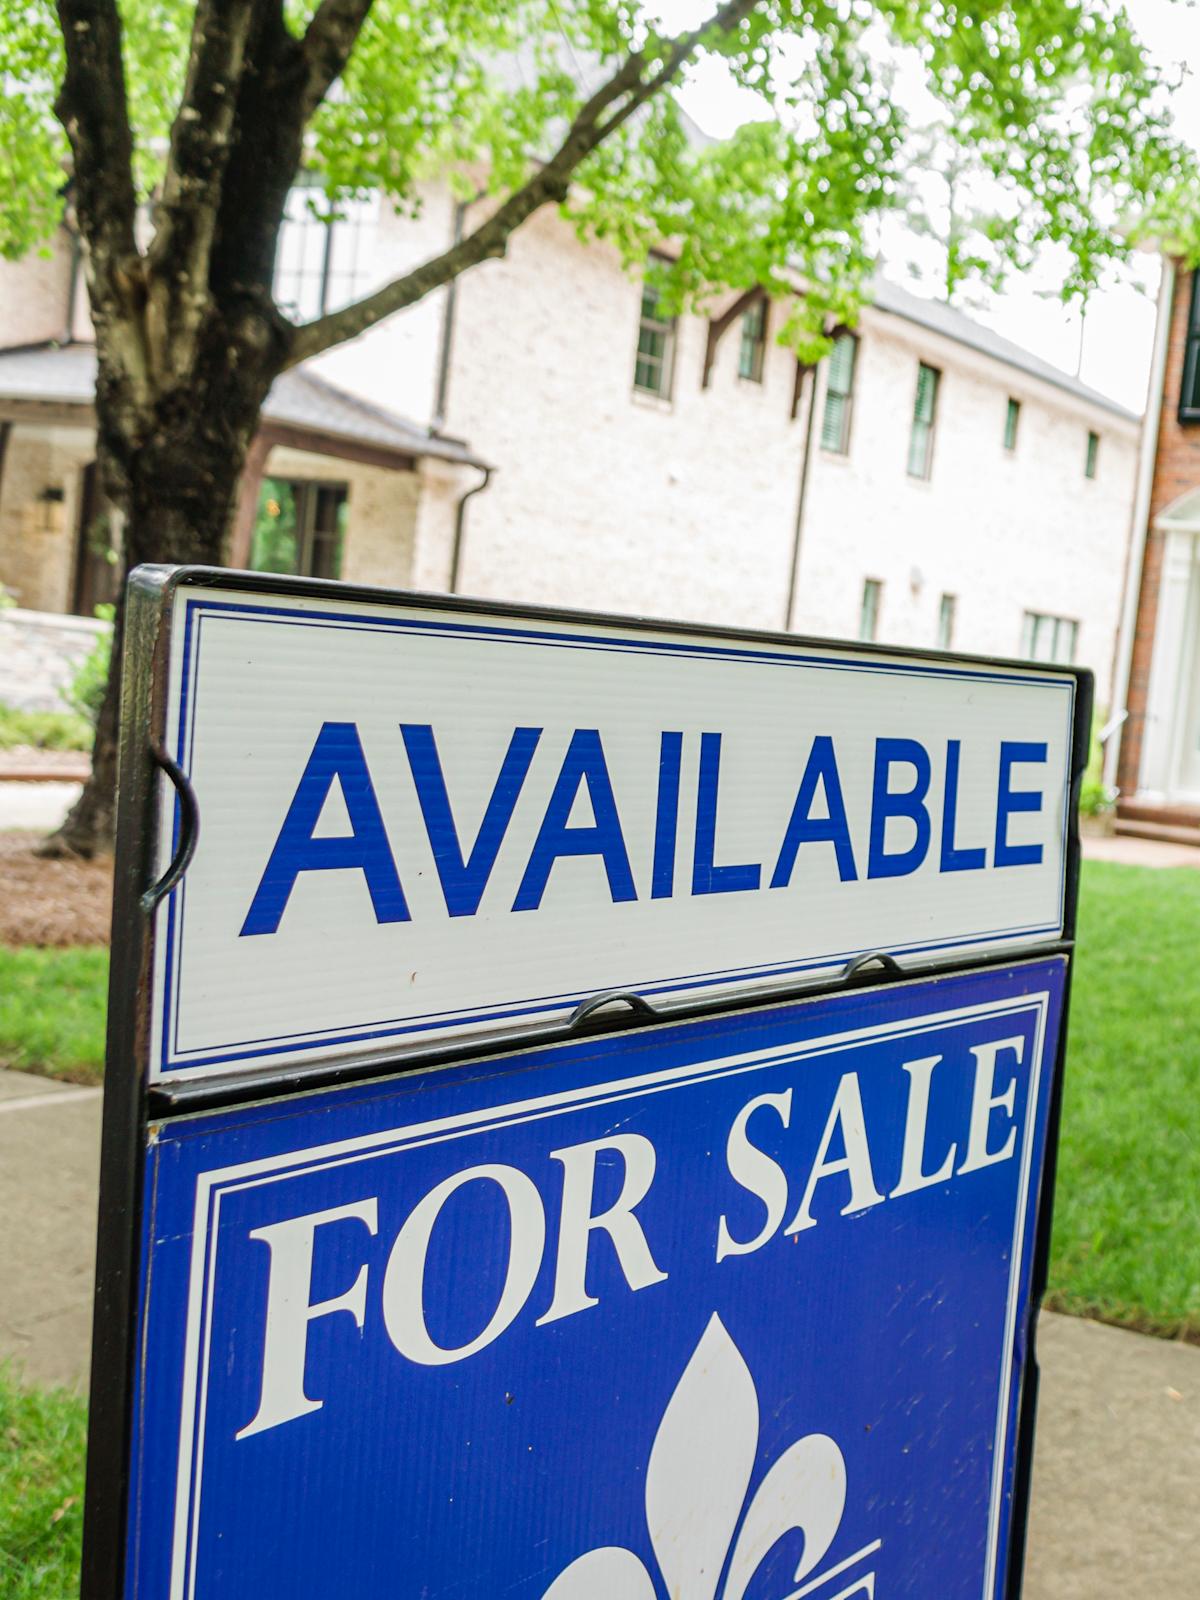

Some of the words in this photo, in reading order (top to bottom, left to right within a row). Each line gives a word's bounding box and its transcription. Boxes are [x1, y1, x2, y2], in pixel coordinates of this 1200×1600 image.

[240, 722, 1049, 936] AVAILABLE
[235, 1133, 669, 1441] FOR
[715, 1035, 1025, 1264] SALE
